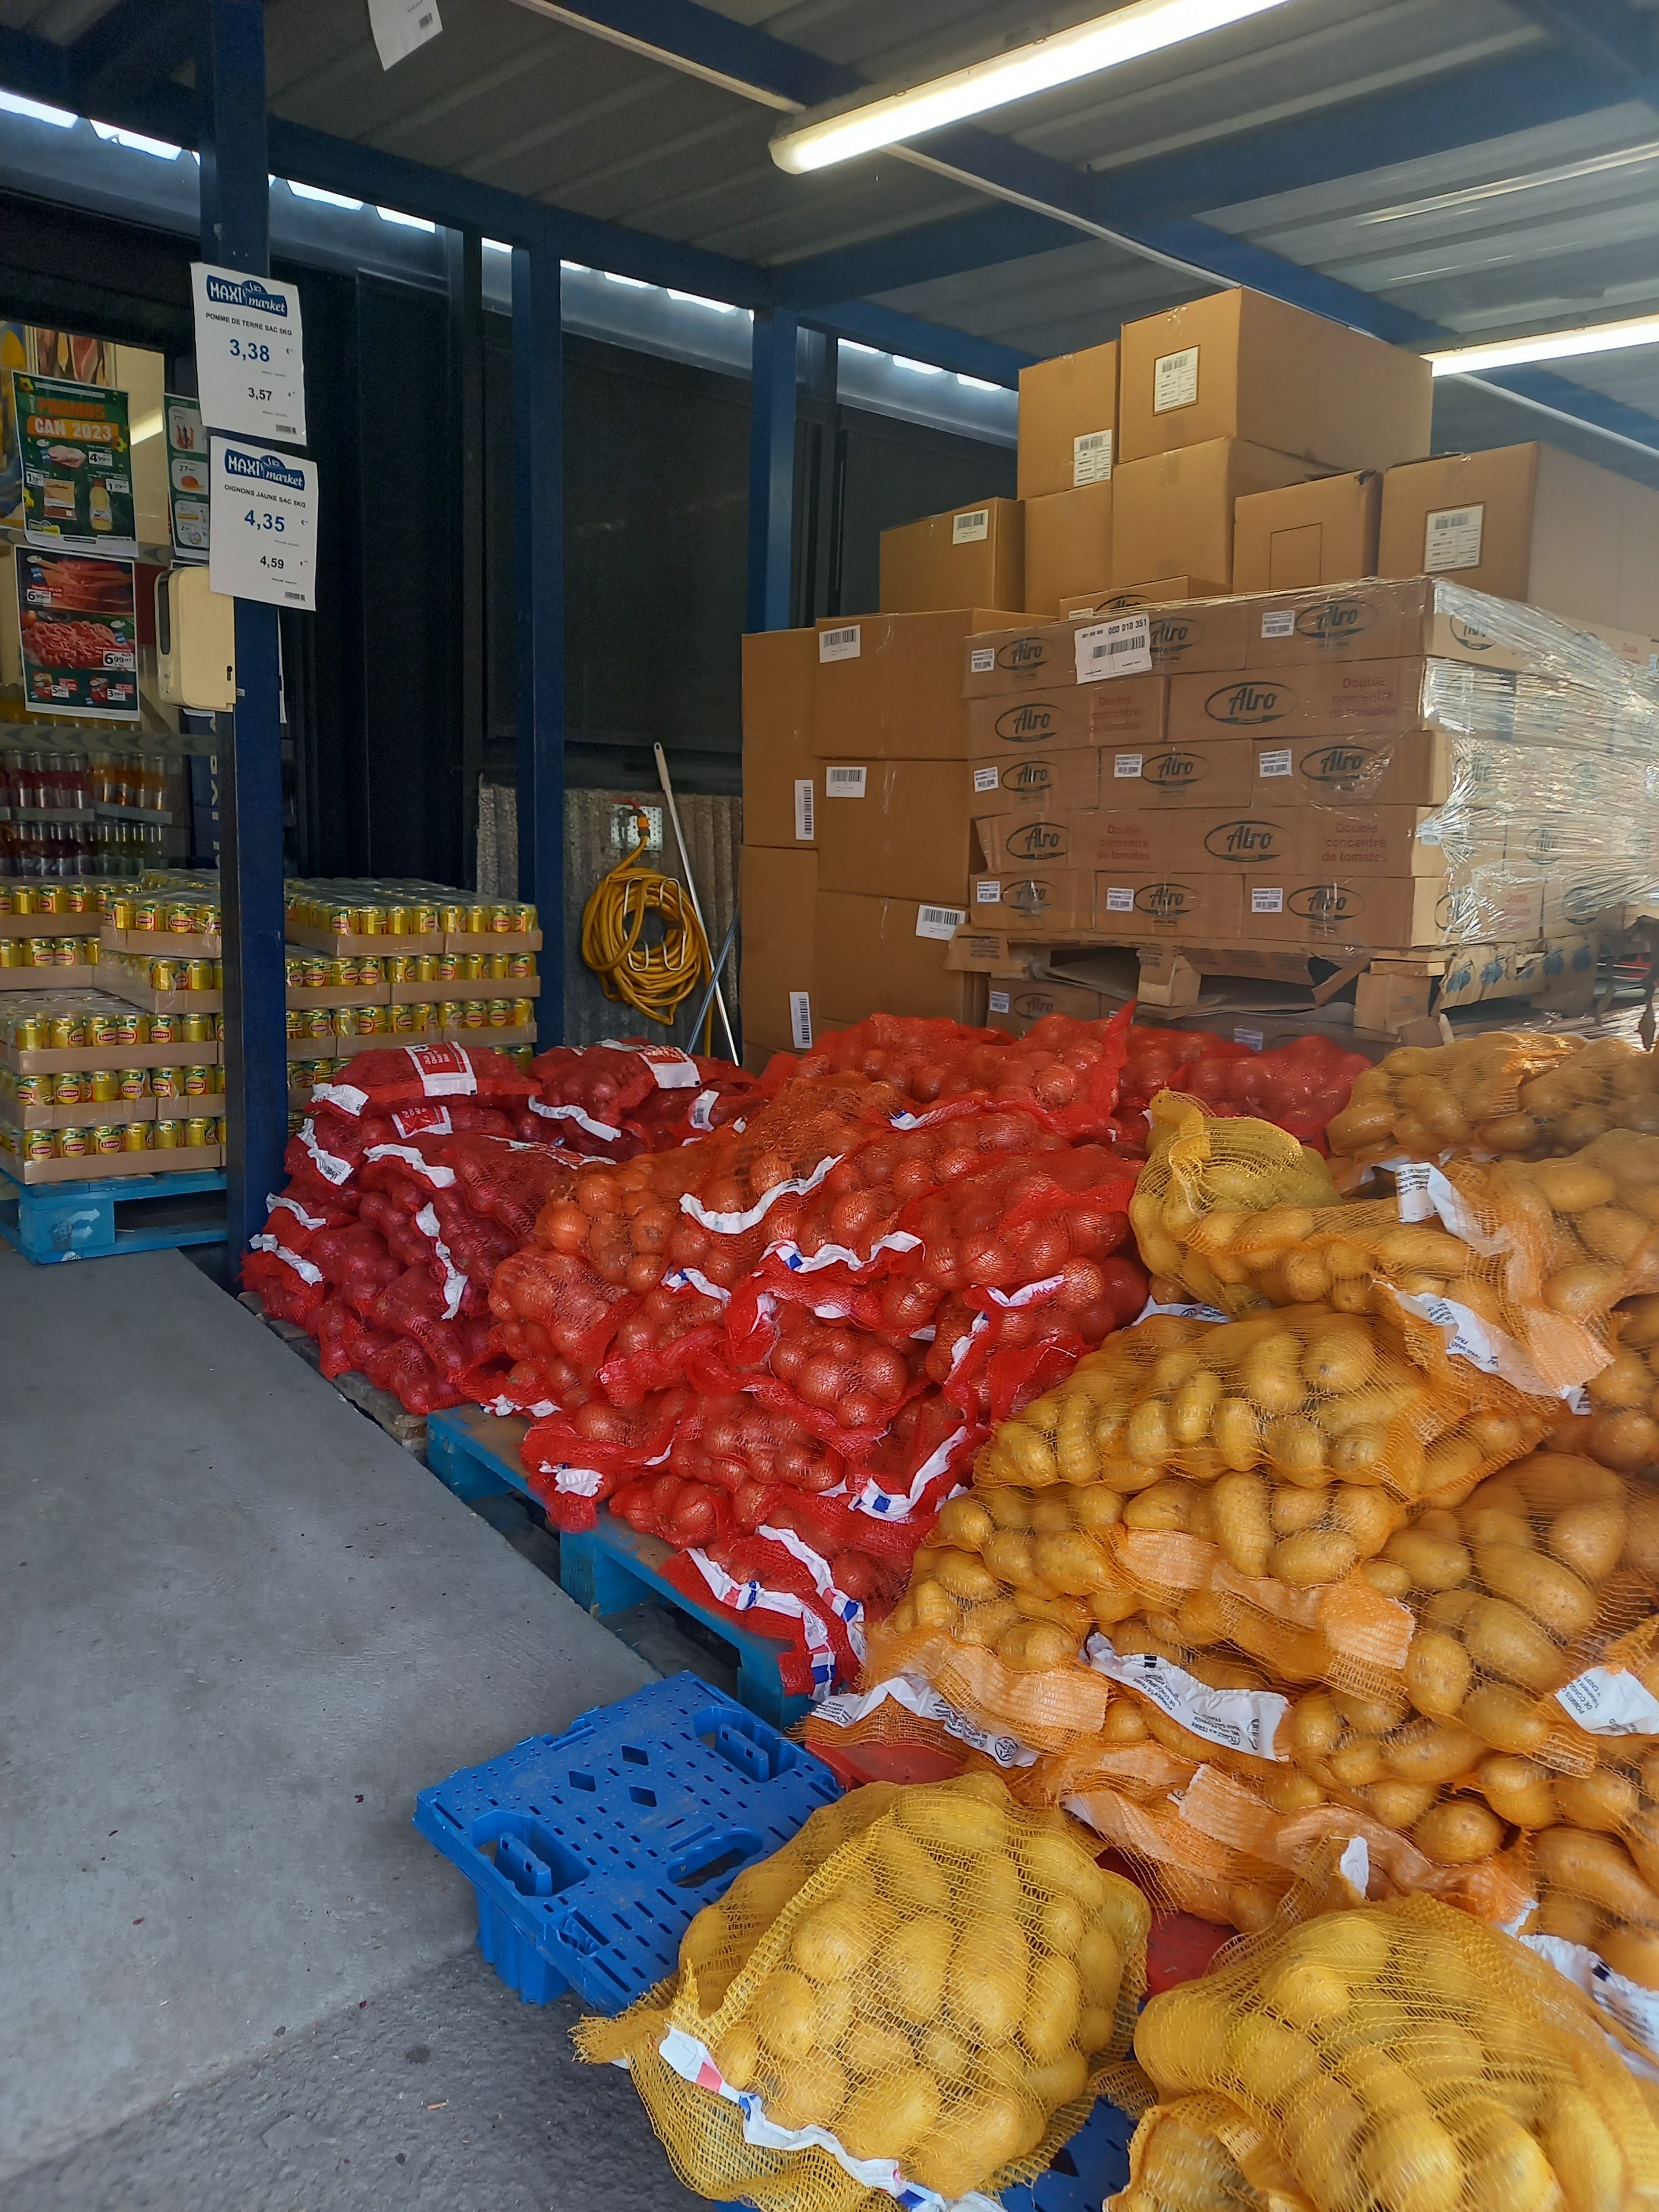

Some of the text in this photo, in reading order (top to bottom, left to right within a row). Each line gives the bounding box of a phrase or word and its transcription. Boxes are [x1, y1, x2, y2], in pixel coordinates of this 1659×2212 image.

[210, 281, 286, 314] MAXI market
[206, 312, 229, 324] POMME
[242, 320, 263, 330] TERRE
[229, 338, 270, 362] 3,38
[248, 387, 272, 401] 3,57
[38, 398, 105, 419] PROMOS
[34, 418, 112, 441] CAN 2023
[228, 455, 303, 487] MAXI market
[224, 484, 254, 496] OIGNONS
[256, 492, 277, 502] JAUNE
[279, 497, 292, 505] SAC
[244, 509, 285, 532] 4,35
[260, 556, 284, 569] 4,59
[1135, 619, 1146, 628] 351
[1316, 606, 1358, 630] Alro
[1011, 642, 1042, 664] Alro
[1228, 686, 1278, 716] Alro
[1014, 708, 1051, 734] Alro
[1158, 756, 1195, 779] Alro
[1321, 750, 1364, 774] Alro
[1025, 827, 1061, 852] Alro
[1226, 825, 1273, 852] Alro
[1565, 1691, 1585, 1715] POMMES
[1583, 1701, 1593, 1710] DE
